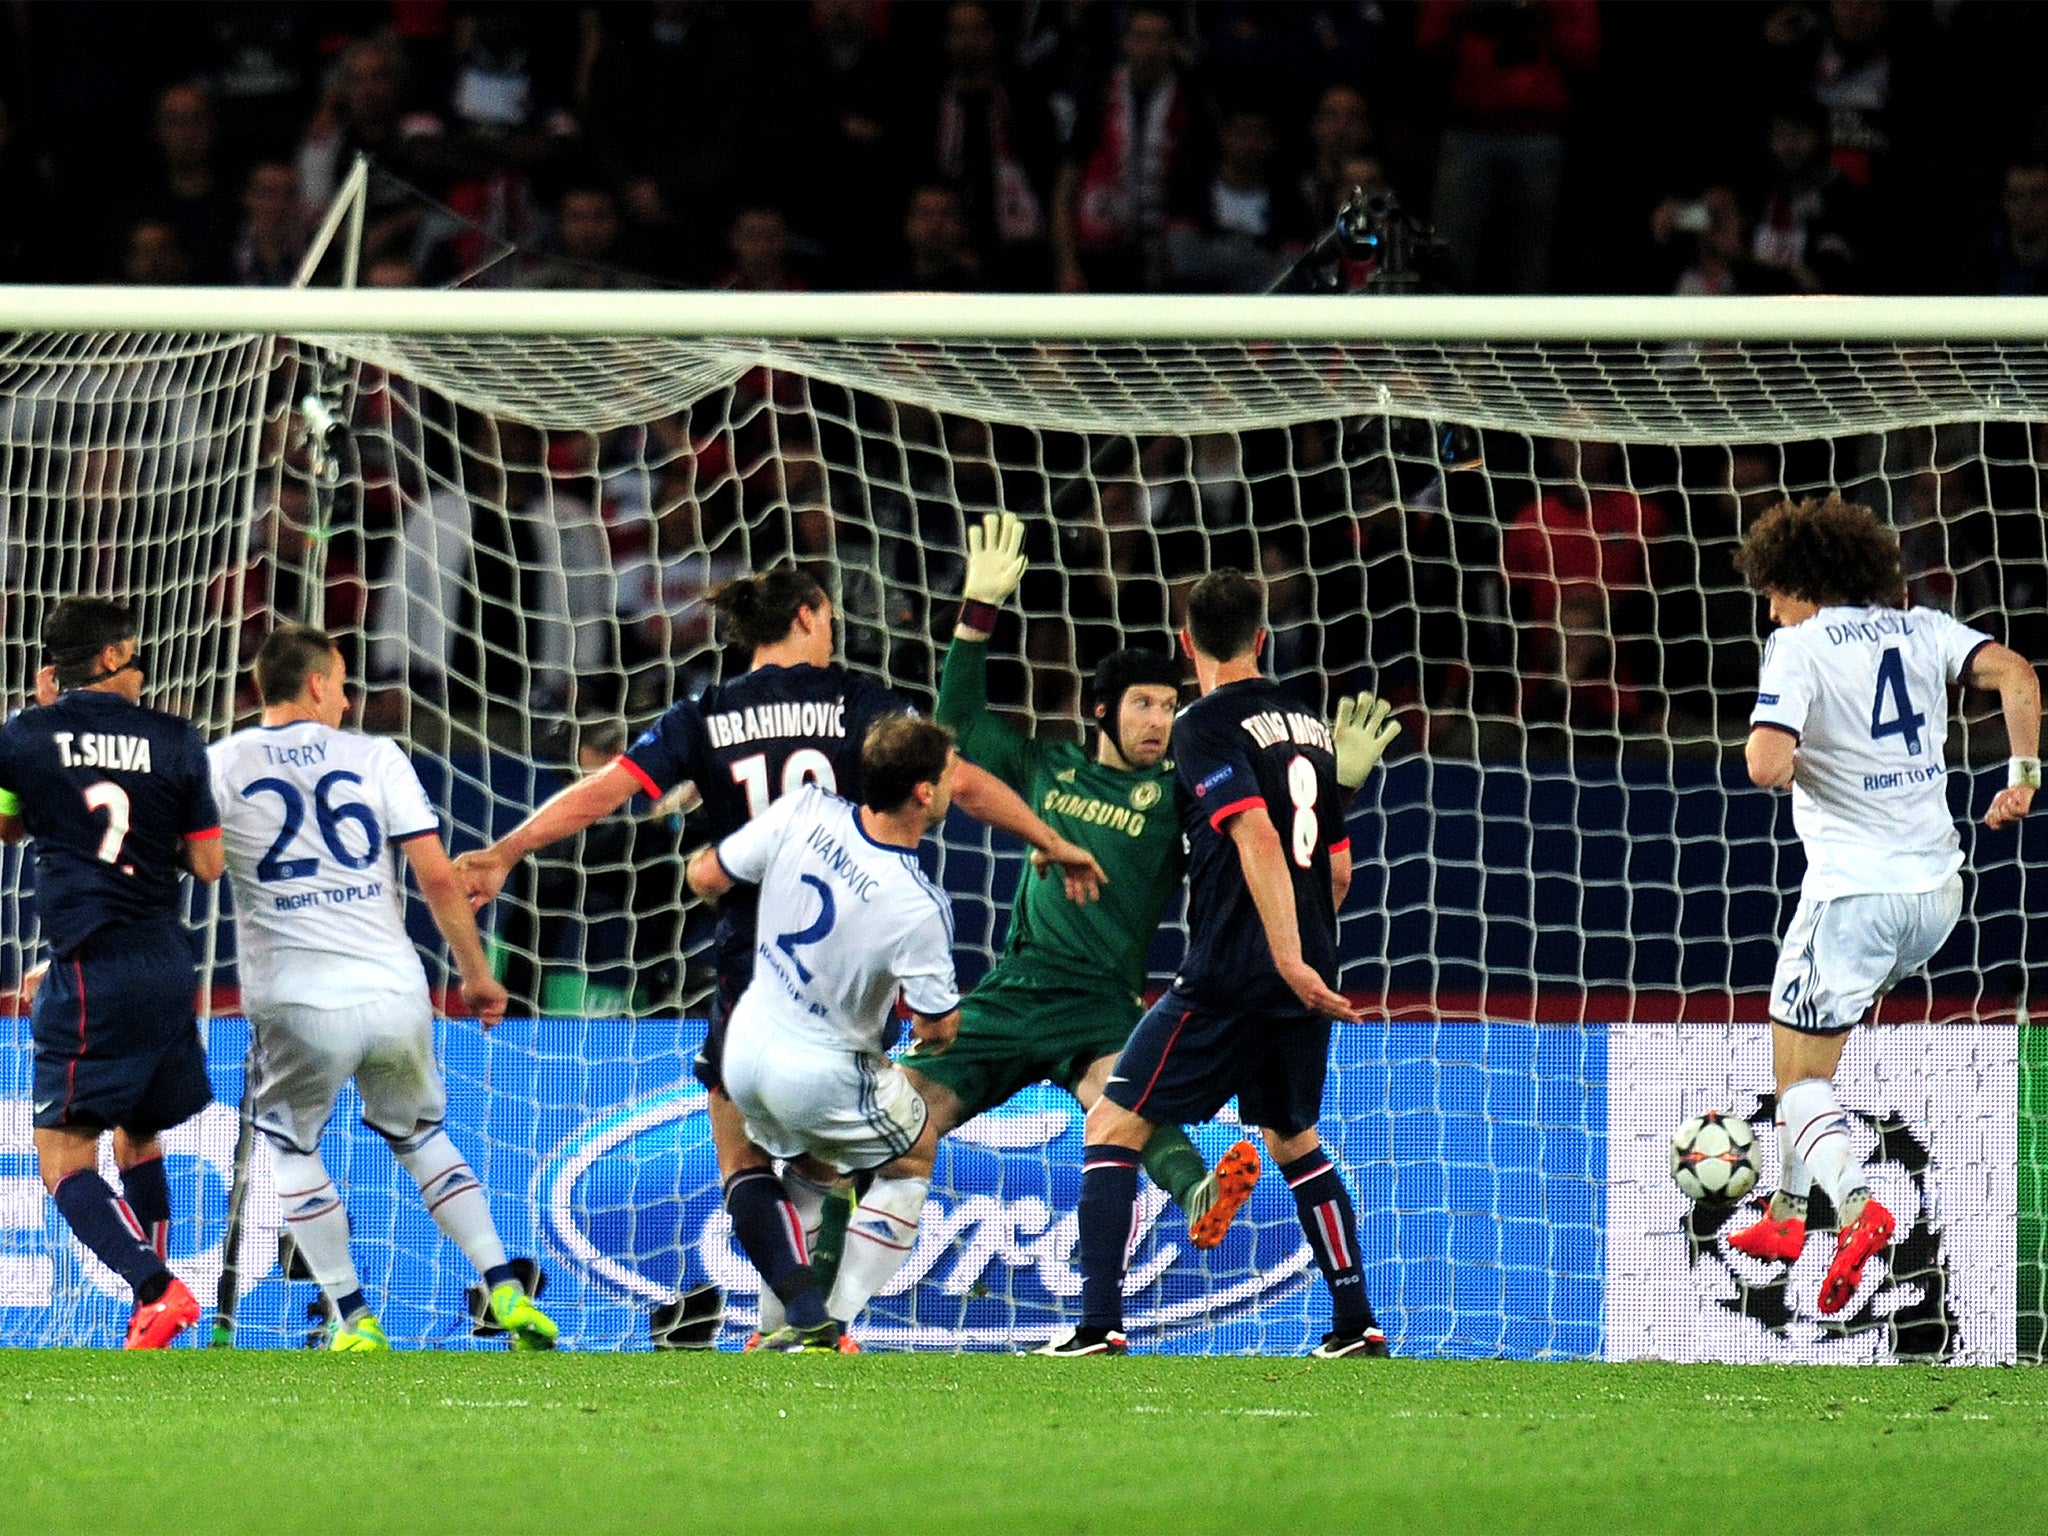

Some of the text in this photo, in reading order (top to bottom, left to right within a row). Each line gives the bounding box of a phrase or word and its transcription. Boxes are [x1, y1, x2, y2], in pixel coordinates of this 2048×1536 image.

[706, 694, 847, 749] IBRAHIMOVIĆ
[1871, 647, 1926, 757] 4
[53, 731, 152, 774] T.SILVA
[1863, 771, 1904, 791] RIGHT
[1905, 770, 1925, 784] TO
[241, 769, 381, 883] 26
[1044, 788, 1146, 837] SAMSUNG
[1287, 754, 1319, 869] 8
[275, 882, 382, 911] RIGHT TO PLAY
[807, 823, 880, 903] IVANOVIC
[776, 873, 837, 985] 2
